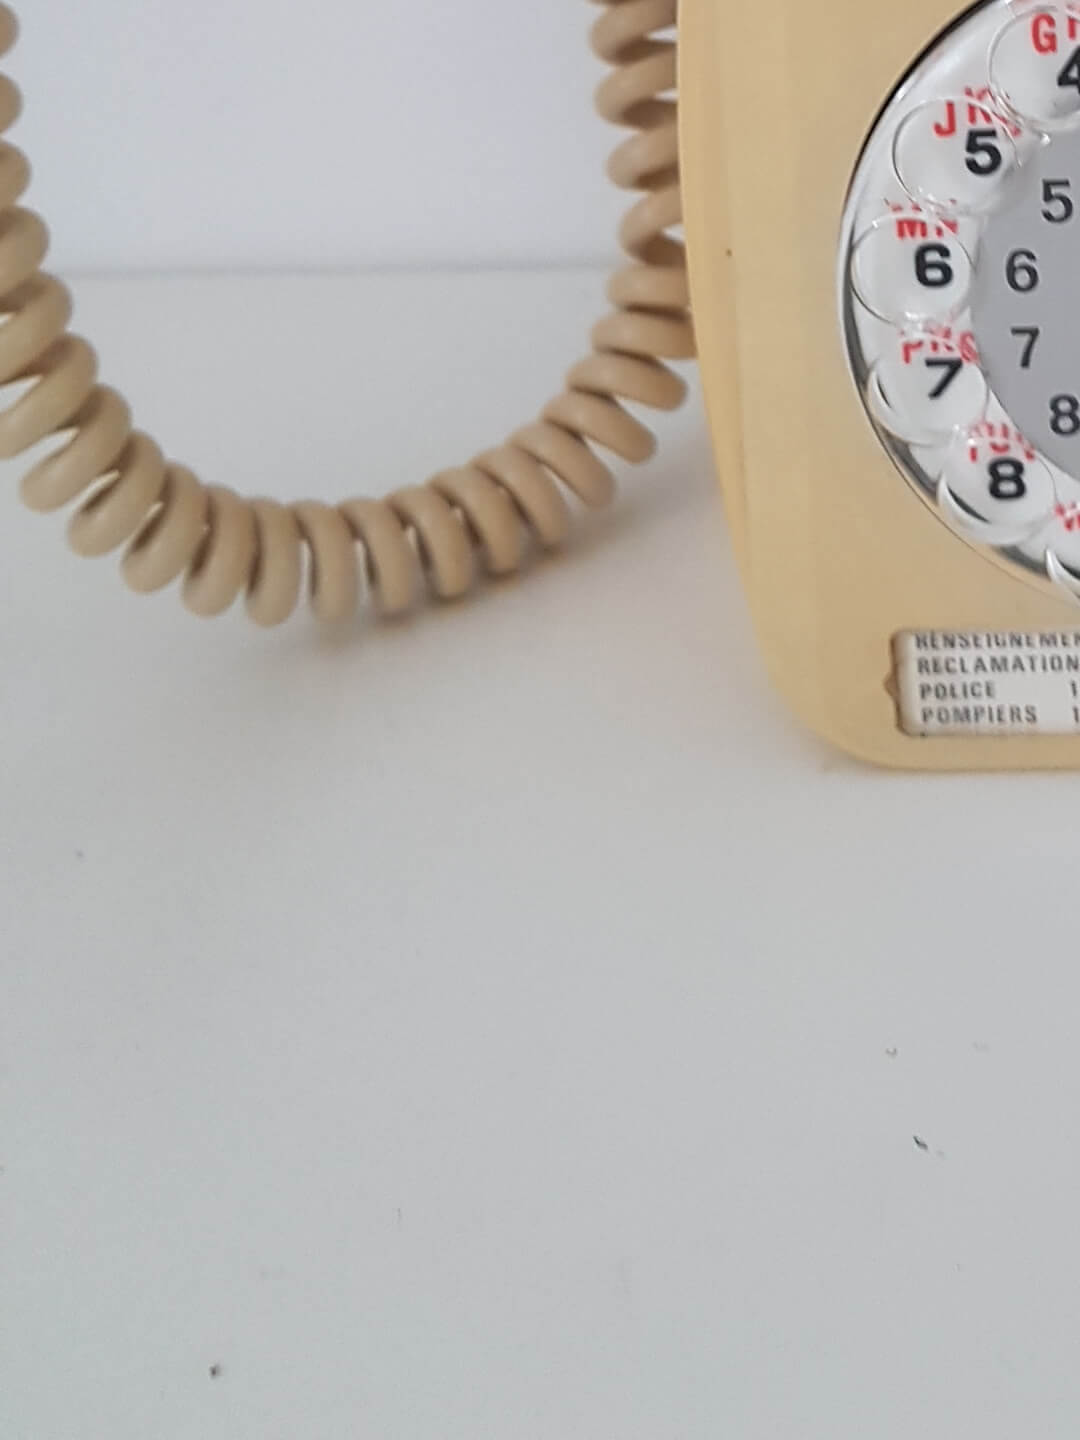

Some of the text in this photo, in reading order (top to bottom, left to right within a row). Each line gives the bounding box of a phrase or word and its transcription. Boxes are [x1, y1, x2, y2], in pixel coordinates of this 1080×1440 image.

[965, 128, 1001, 175] 5
[1041, 178, 1073, 223] 5
[914, 243, 953, 287] 6
[1005, 248, 1039, 292] 6
[1010, 326, 1039, 368] 7
[924, 358, 963, 400] 7
[1049, 394, 1080, 436] 8
[988, 457, 1026, 499] 8
[919, 679, 996, 700] POLICE
[921, 704, 1038, 725] POMPIERS
